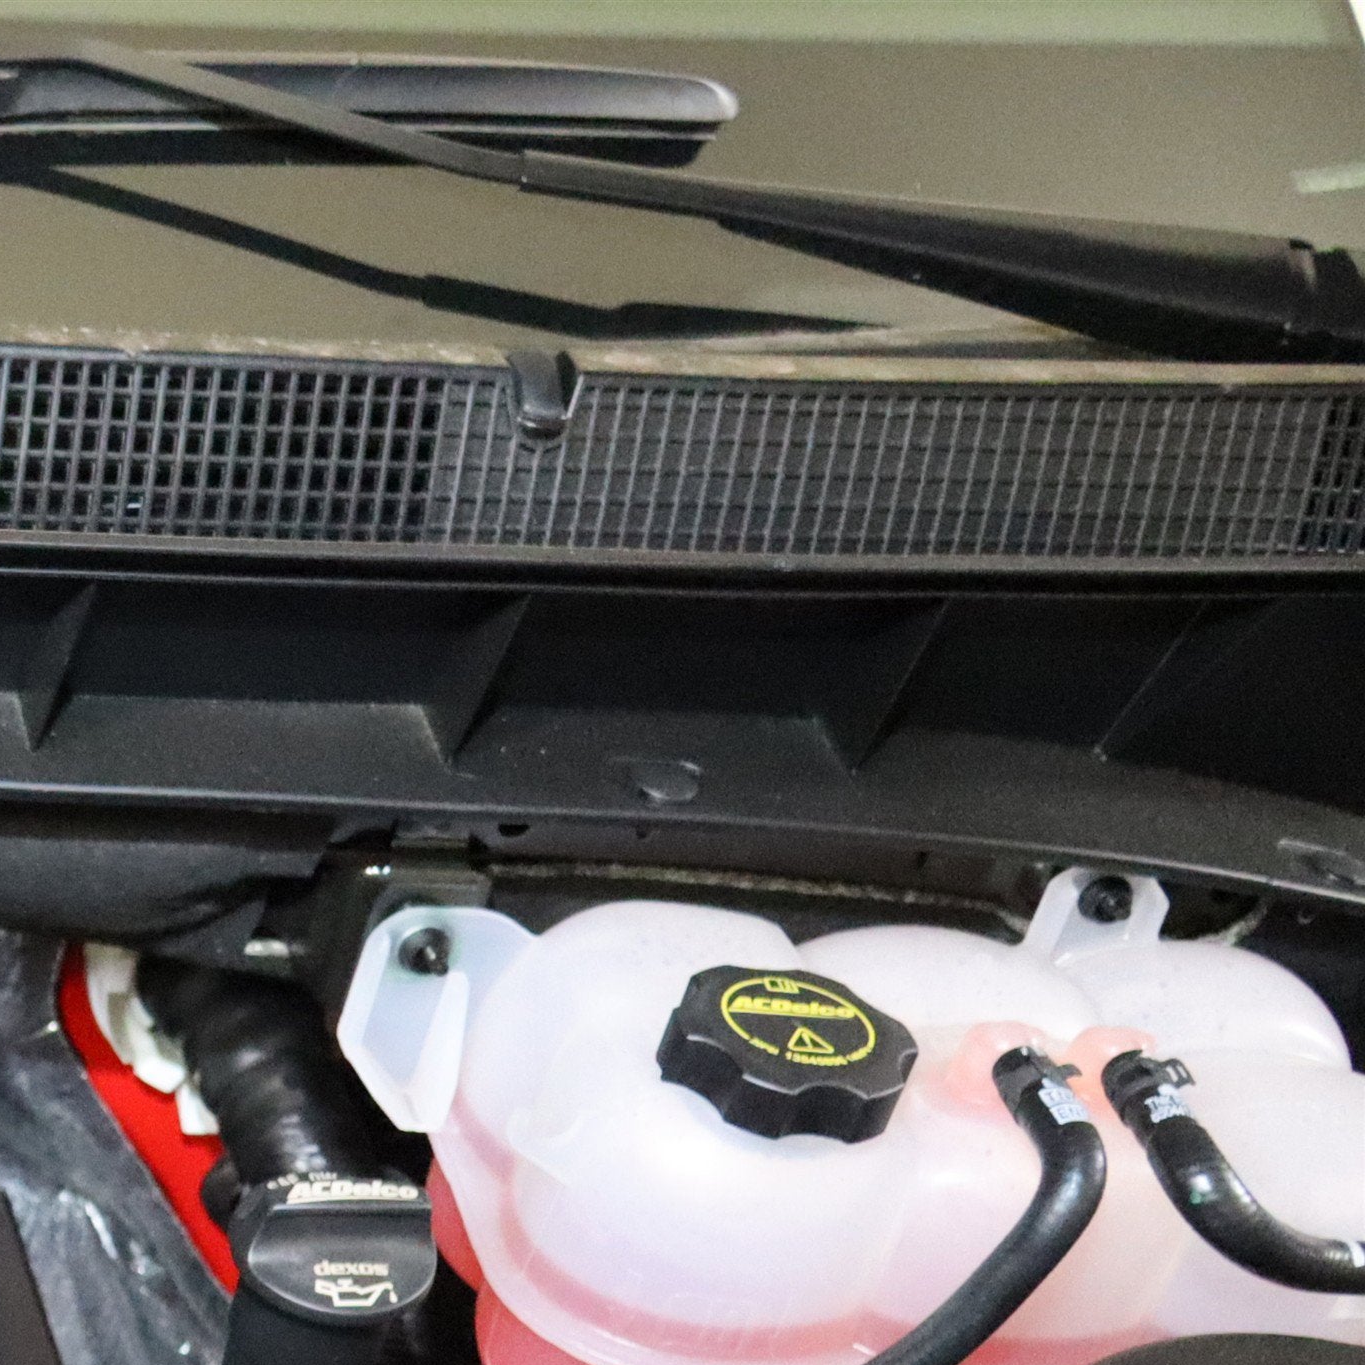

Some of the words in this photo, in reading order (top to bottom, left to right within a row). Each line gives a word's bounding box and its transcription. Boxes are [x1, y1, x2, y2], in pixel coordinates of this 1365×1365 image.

[730, 995, 857, 1018] ACDelco
[287, 1179, 419, 1203] ACDelco
[313, 1258, 389, 1277] dexos
